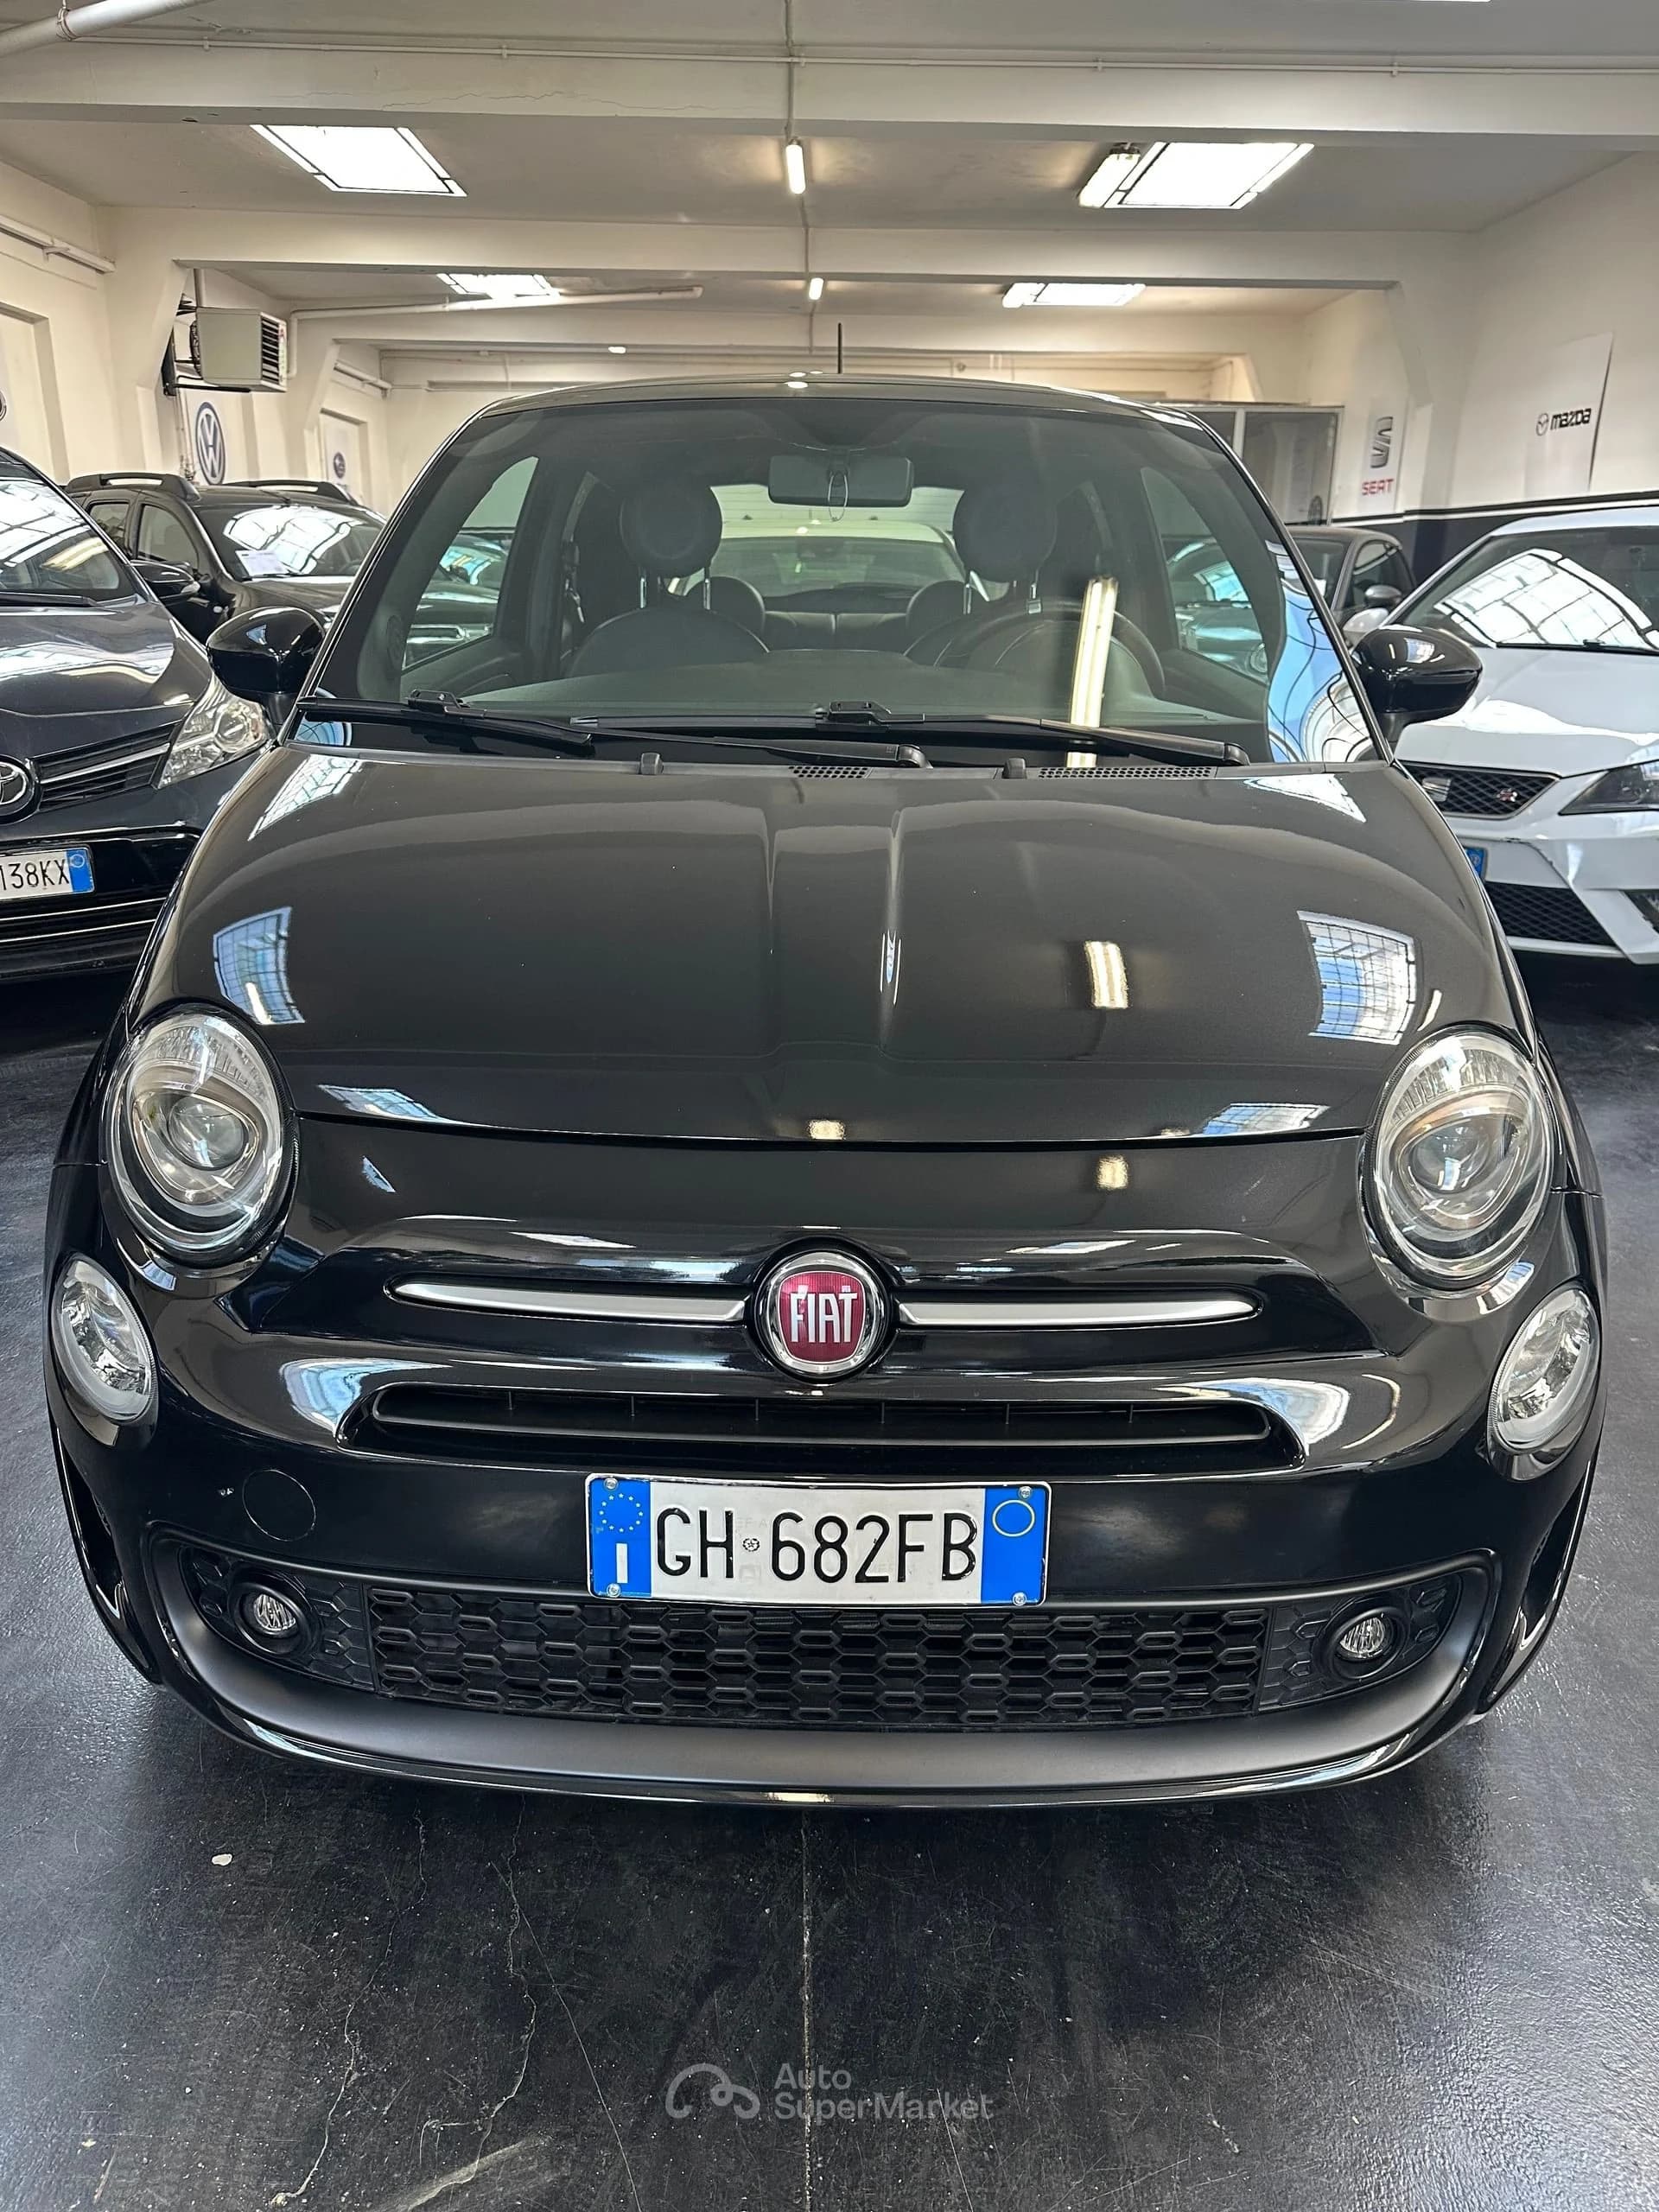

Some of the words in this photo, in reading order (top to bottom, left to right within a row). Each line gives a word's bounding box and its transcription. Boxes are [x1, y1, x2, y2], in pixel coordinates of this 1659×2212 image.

[1362, 478, 1395, 496] SEAT
[790, 1292, 858, 1344] FIAT
[657, 1507, 734, 1579] GH
[771, 1511, 977, 1584] 682FB
